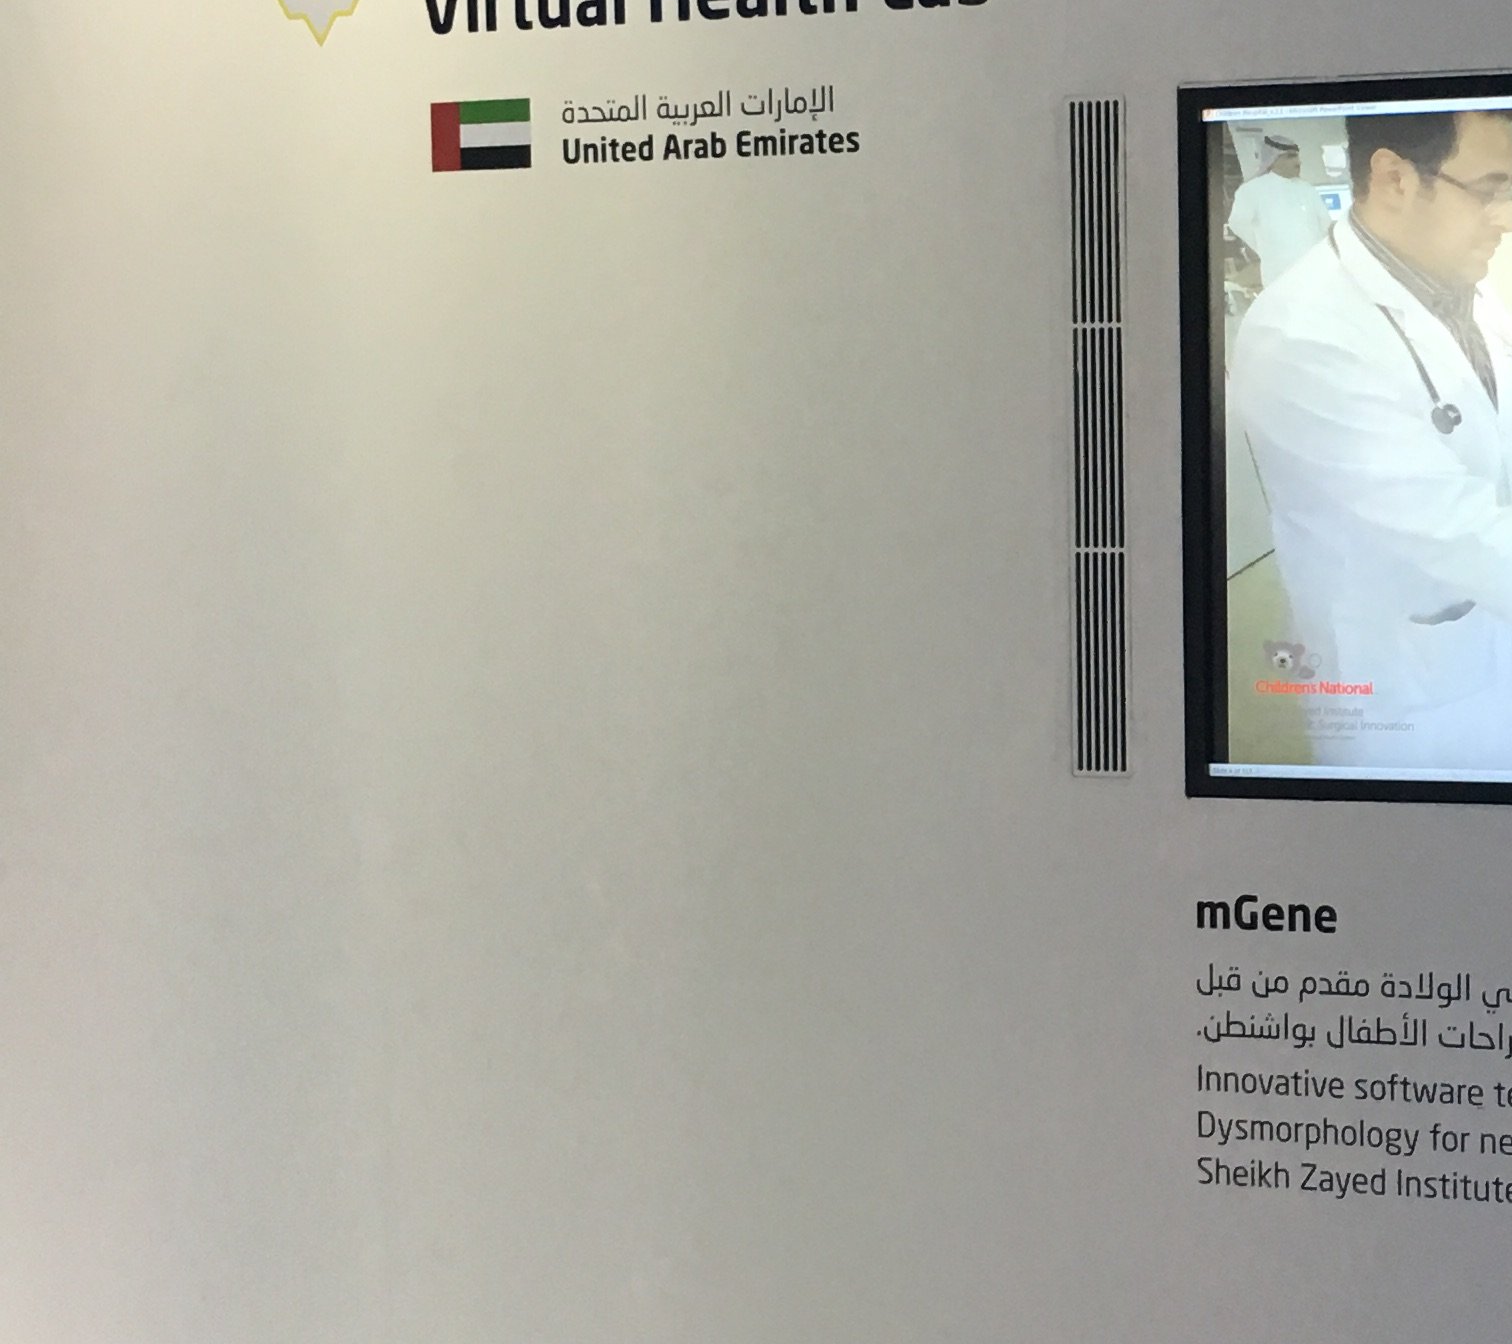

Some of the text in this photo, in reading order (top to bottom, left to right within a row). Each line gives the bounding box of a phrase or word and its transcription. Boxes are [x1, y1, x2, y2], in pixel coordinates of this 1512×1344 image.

[562, 85, 833, 126] الإمارات العربية المتحدة
[563, 128, 860, 164] United Arab Emirates
[1319, 680, 1373, 696] National
[1360, 719, 1415, 732] Innovation
[1197, 894, 1337, 933] mGene
[1197, 963, 1241, 997] قبل
[1252, 971, 1289, 998] من
[1299, 971, 1369, 1004] مقدم
[1381, 972, 1470, 1009] الولادة
[1327, 1012, 1426, 1049] الأطفال
[1198, 1064, 1344, 1099] Innovative
[1355, 1073, 1484, 1106] software
[1198, 1111, 1419, 1157] Dysmorphology
[1429, 1123, 1470, 1153] for
[1197, 1157, 1289, 1188] Sheikh
[1301, 1163, 1386, 1199] Zayed
